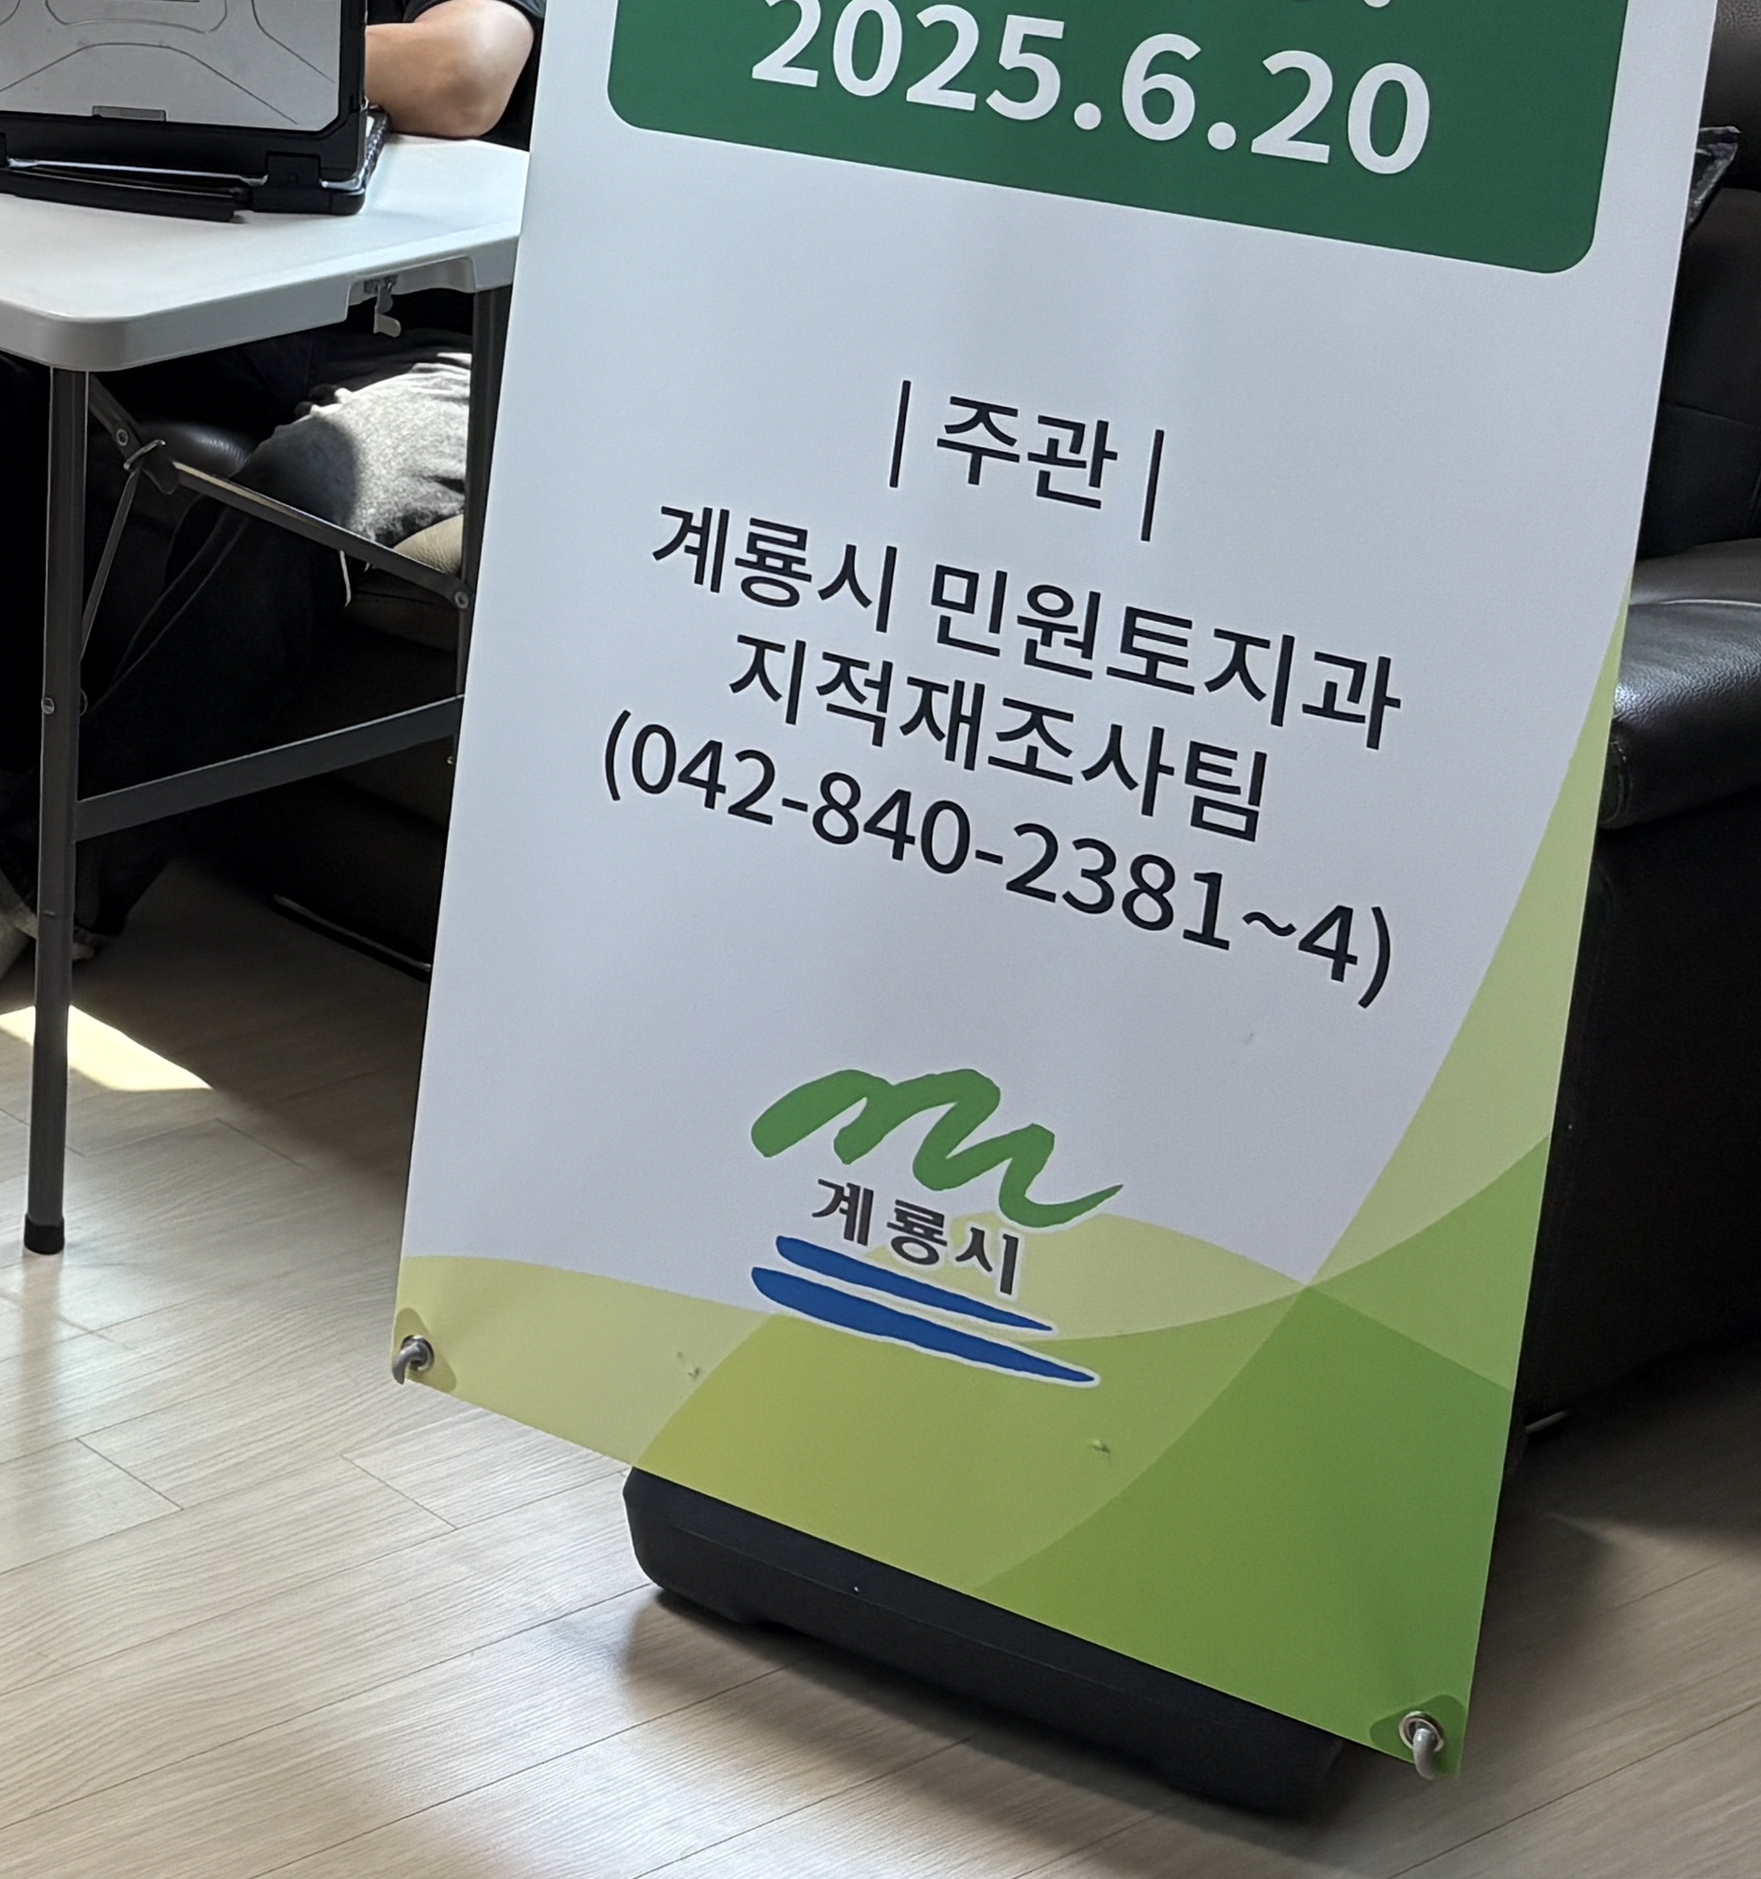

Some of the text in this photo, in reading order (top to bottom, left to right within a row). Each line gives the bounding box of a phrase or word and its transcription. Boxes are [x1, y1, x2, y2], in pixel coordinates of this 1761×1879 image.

[935, 394, 1119, 511] 주관
[650, 502, 1401, 751] 계룡시 민원토지과
[728, 633, 1270, 844] 지적재조사팀
[600, 709, 1396, 1009] (042-840-2381~4)
[811, 1178, 1022, 1295] 계룡시
